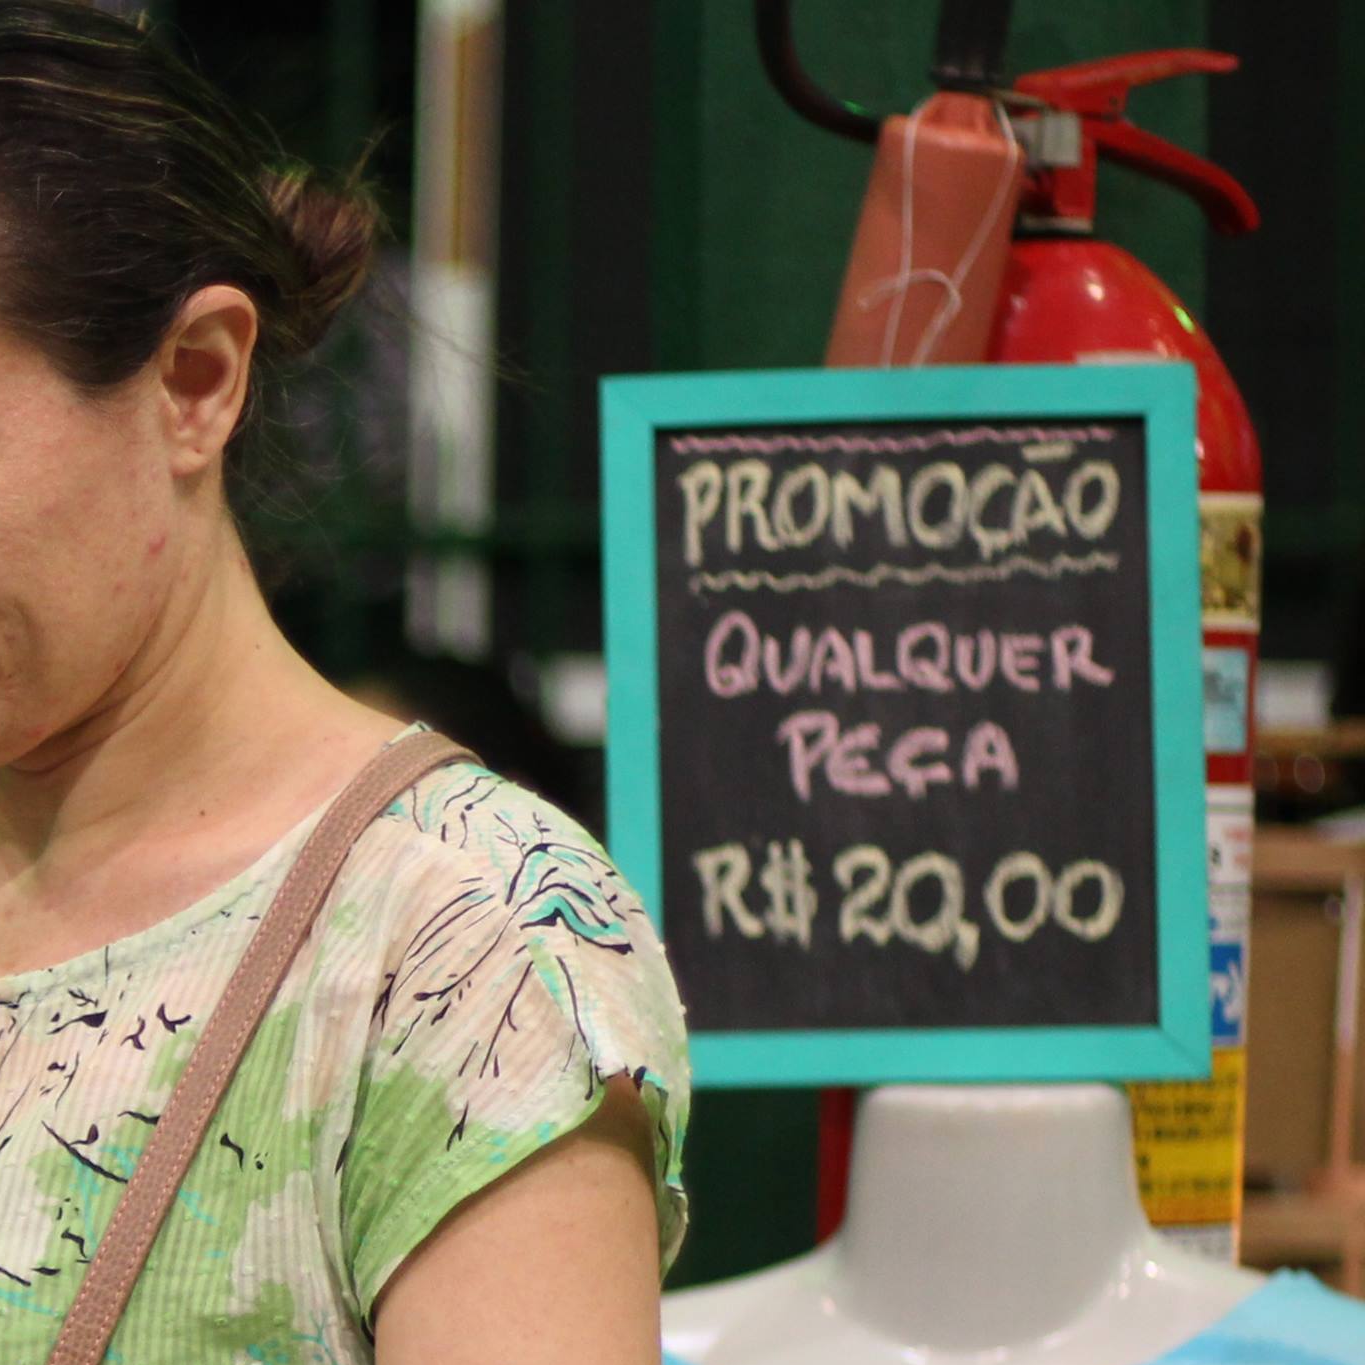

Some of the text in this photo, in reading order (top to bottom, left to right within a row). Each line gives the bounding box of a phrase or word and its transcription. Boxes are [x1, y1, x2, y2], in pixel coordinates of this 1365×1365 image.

[680, 444, 1121, 567] PROMOÇÃO
[704, 611, 1115, 698] QUALQUER
[777, 710, 1020, 801] PEÇA
[693, 839, 1126, 972] R$ 20,00
